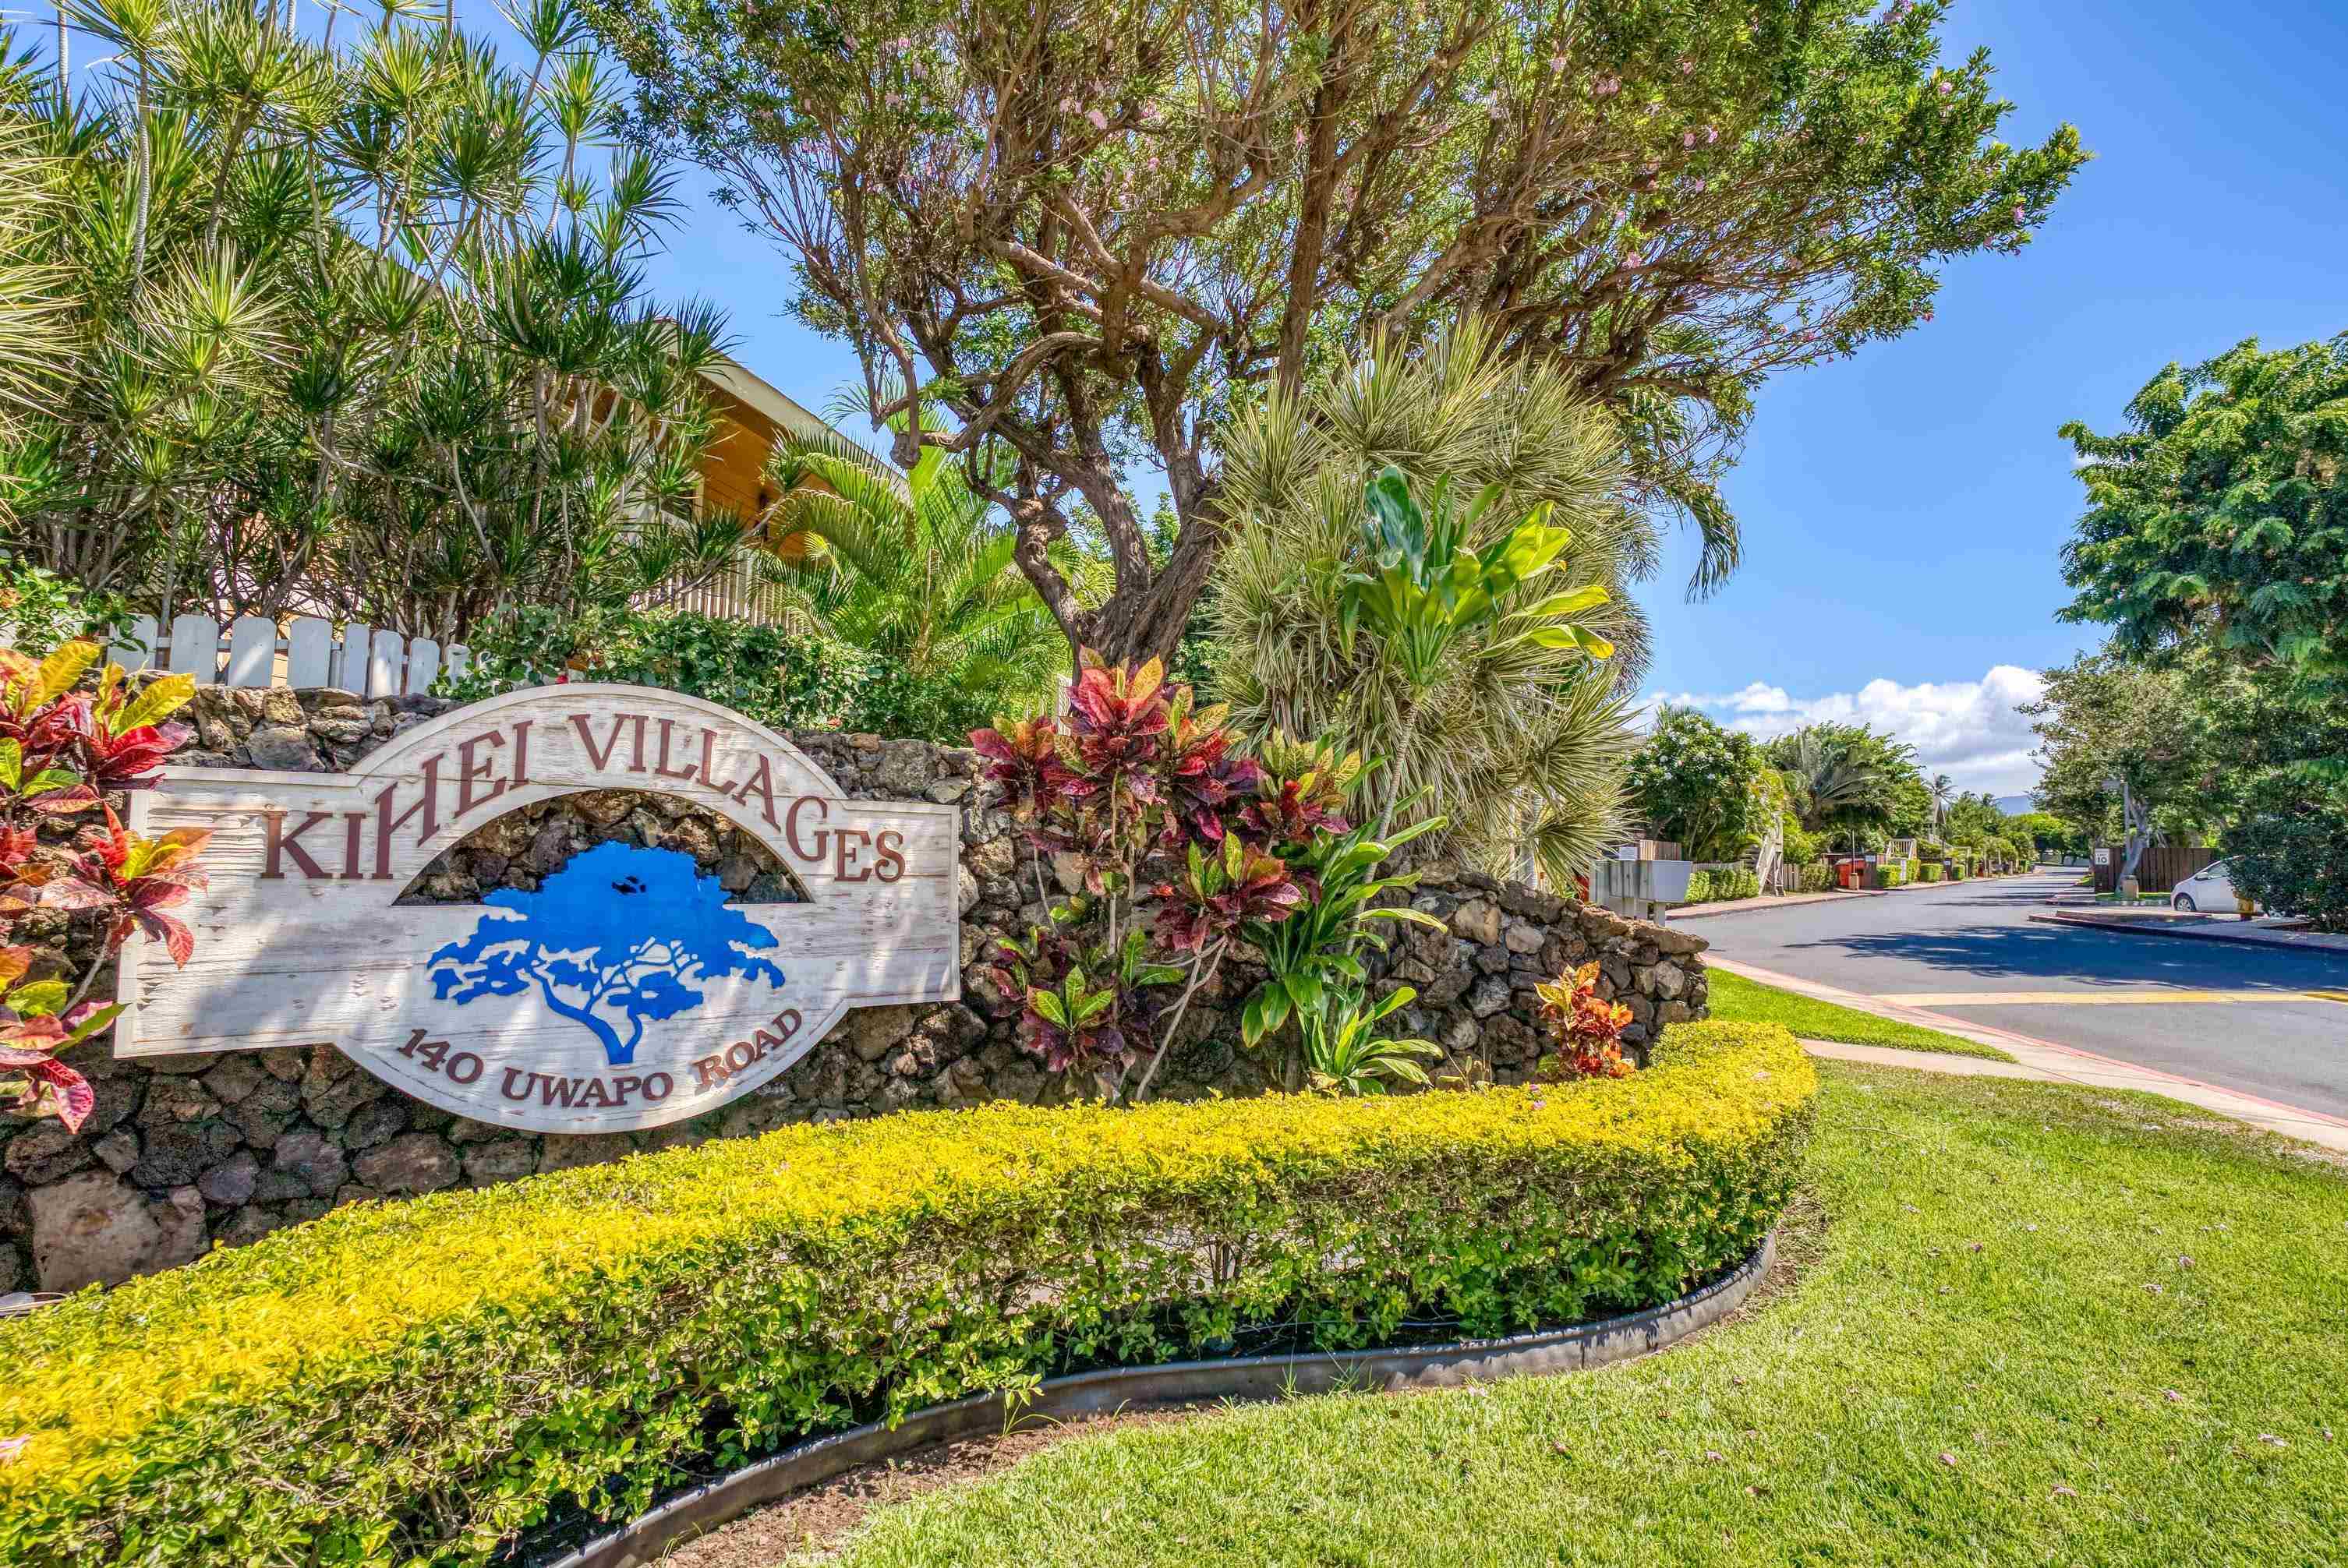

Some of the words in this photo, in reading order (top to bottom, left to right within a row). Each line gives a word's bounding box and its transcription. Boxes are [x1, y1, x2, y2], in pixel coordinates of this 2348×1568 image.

[261, 720, 532, 879] KIHEI
[568, 714, 906, 882] VILLAGES
[397, 1029, 483, 1084] 140
[501, 1067, 674, 1107] UWAPO
[692, 1008, 802, 1087] ROAD
